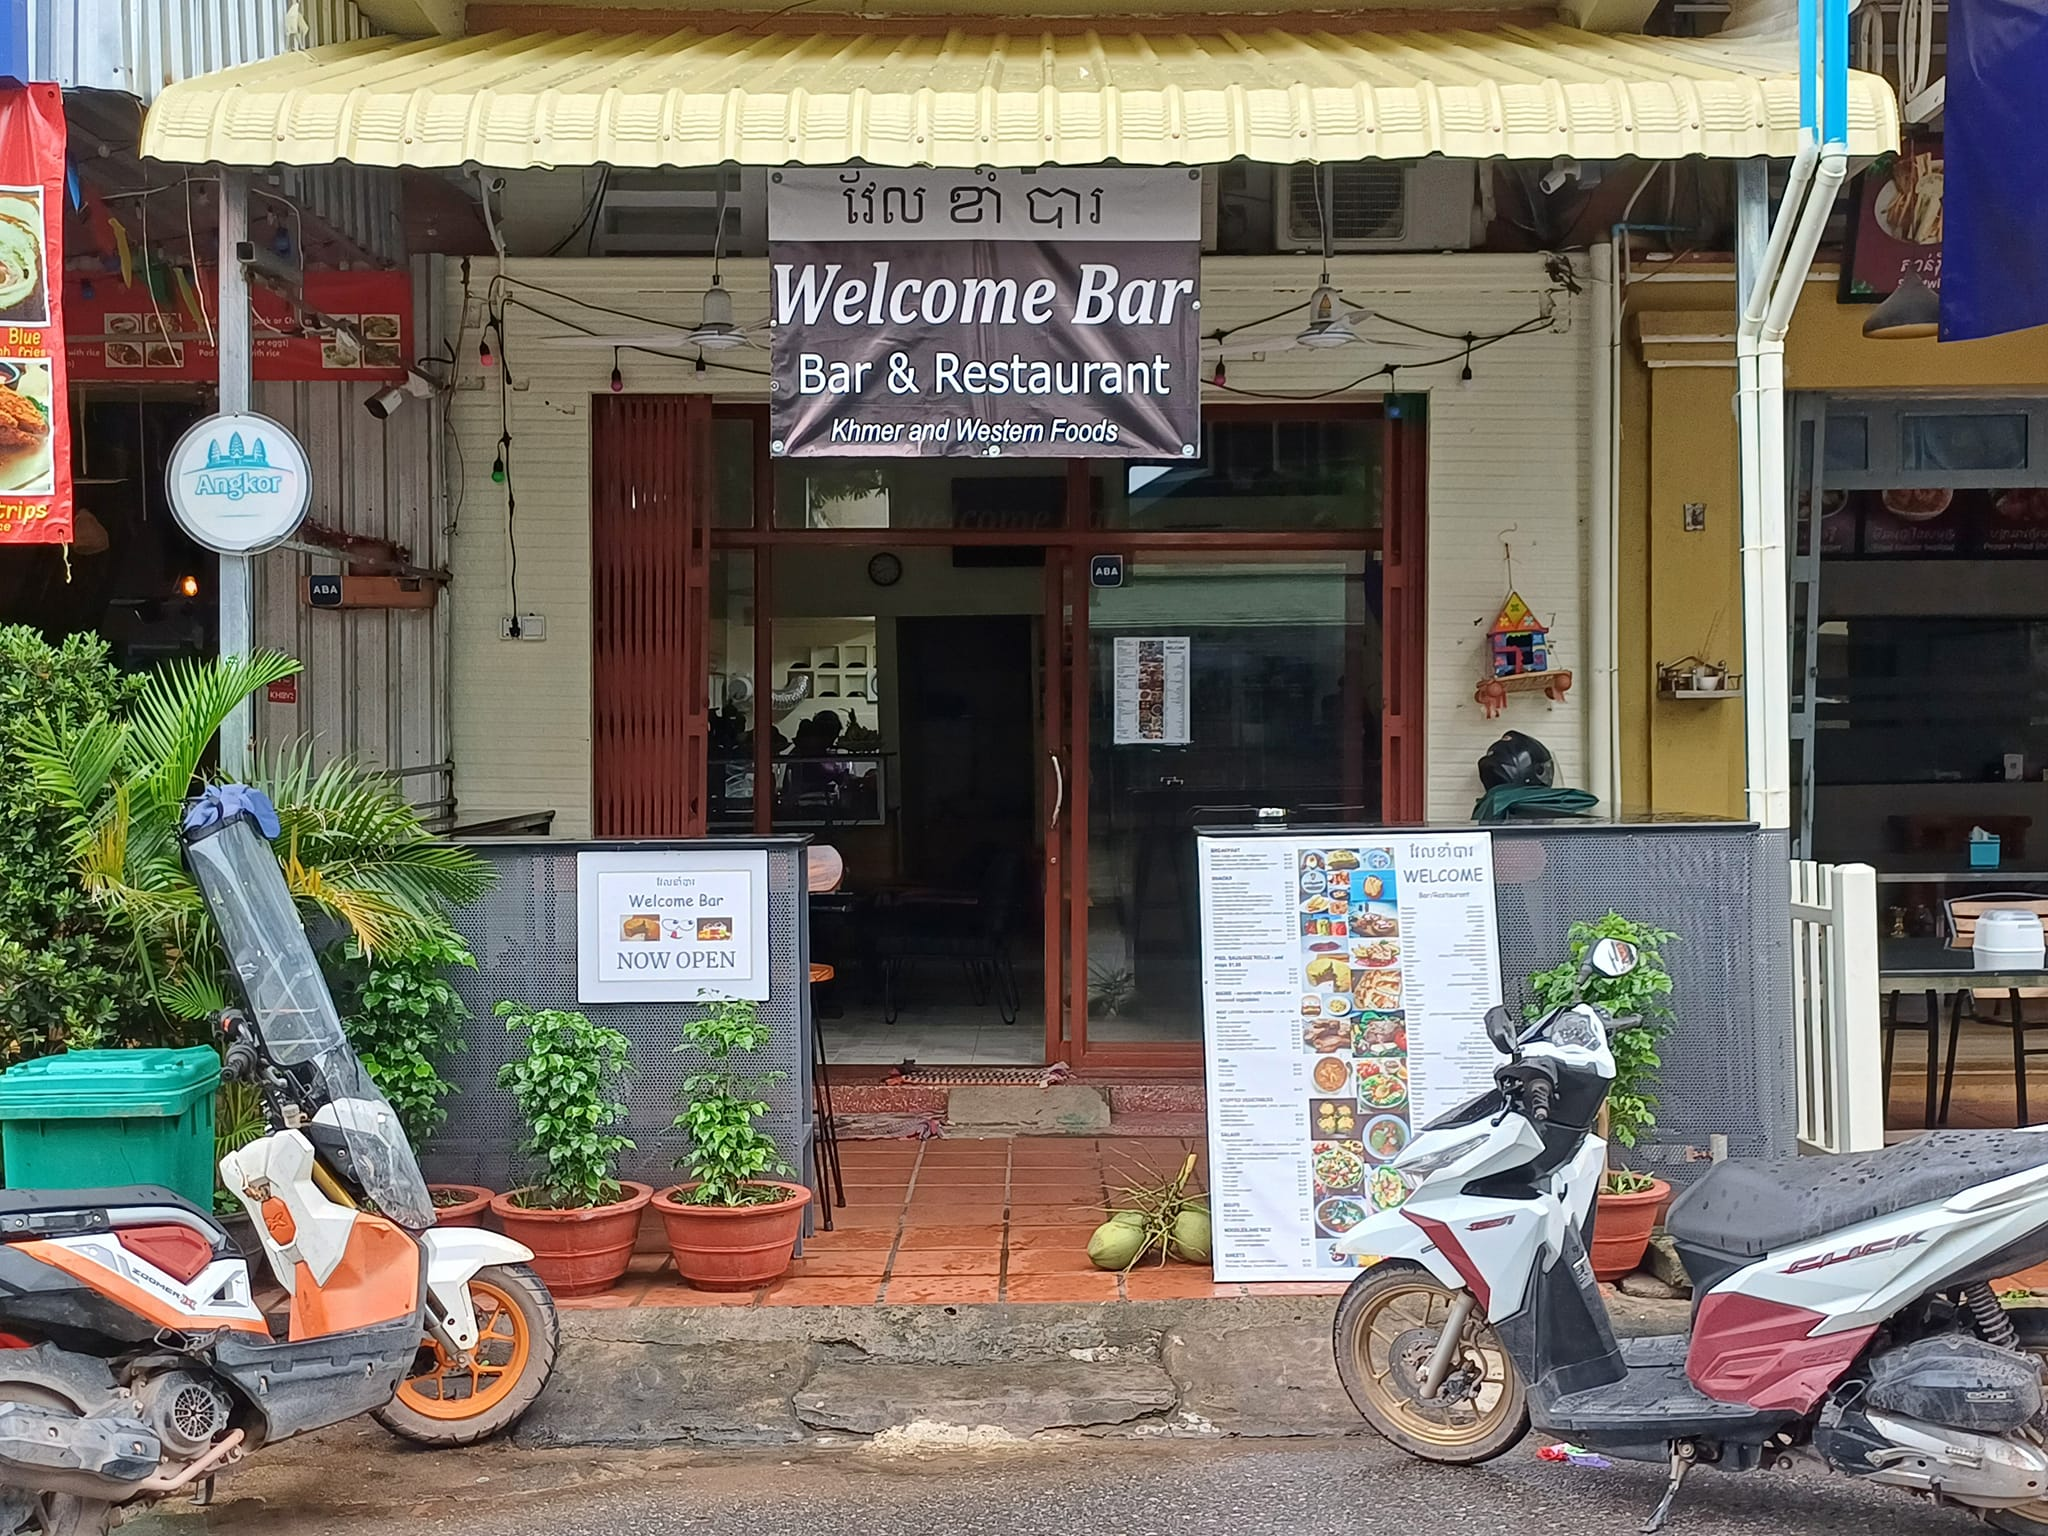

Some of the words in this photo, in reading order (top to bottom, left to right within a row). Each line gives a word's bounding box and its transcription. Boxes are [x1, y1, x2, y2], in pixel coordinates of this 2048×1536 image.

[773, 260, 1057, 326] Welcome
[1071, 262, 1195, 325] Bar
[8, 327, 41, 345] Blue
[18, 345, 47, 357] fries
[798, 352, 872, 394] Bar
[888, 352, 919, 394] &
[935, 352, 1171, 394] Restaurant
[830, 418, 904, 443] Khmer
[907, 419, 951, 442] and
[955, 418, 1045, 443] Western
[1049, 418, 1119, 442] Foods
[195, 471, 282, 501] Angkor
[1095, 567, 1119, 576] ABA
[313, 585, 338, 594] ABA
[1403, 867, 1484, 884] WELCOME
[628, 893, 694, 908] Welcome
[699, 893, 724, 907] Bar
[617, 951, 671, 970] NOW
[676, 951, 736, 969] OPEN
